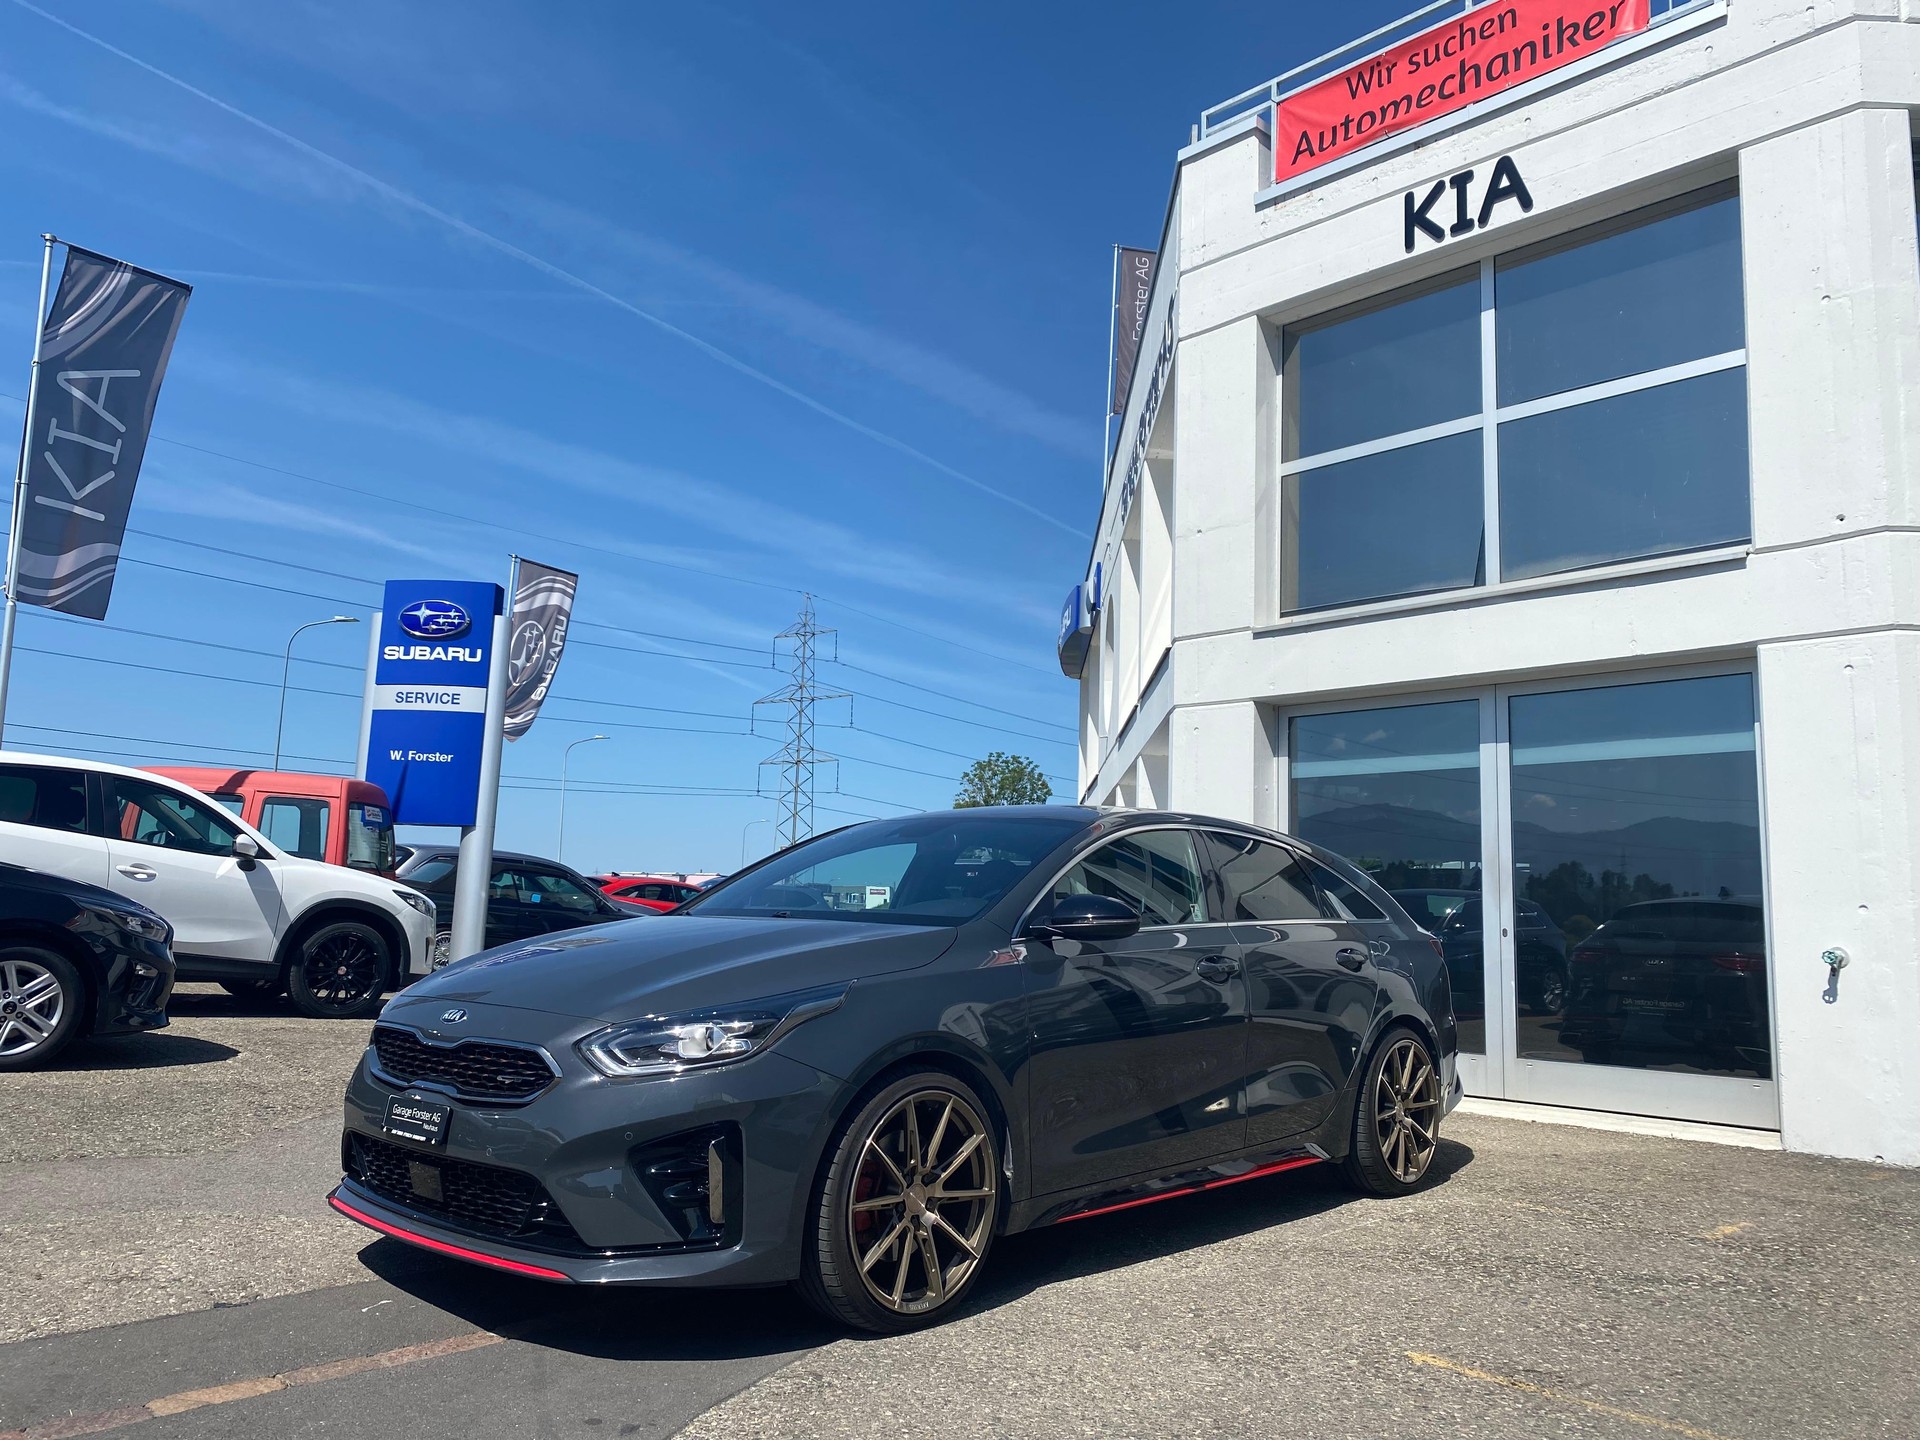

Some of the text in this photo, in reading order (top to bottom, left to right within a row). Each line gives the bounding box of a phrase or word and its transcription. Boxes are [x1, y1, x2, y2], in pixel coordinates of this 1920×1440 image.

[1345, 8, 1517, 100] Wir suchen
[1290, 0, 1626, 166] Automechaniker
[1404, 155, 1534, 253] KIA
[1135, 256, 1149, 281] AG
[35, 369, 141, 522] KIA
[383, 645, 482, 663] SUBARU
[530, 615, 567, 702] SUBARU
[395, 691, 461, 706] SERVICE
[389, 750, 453, 763] W. Forster
[442, 1009, 464, 1021] KIA
[392, 1103, 442, 1123] Garage Forster AG
